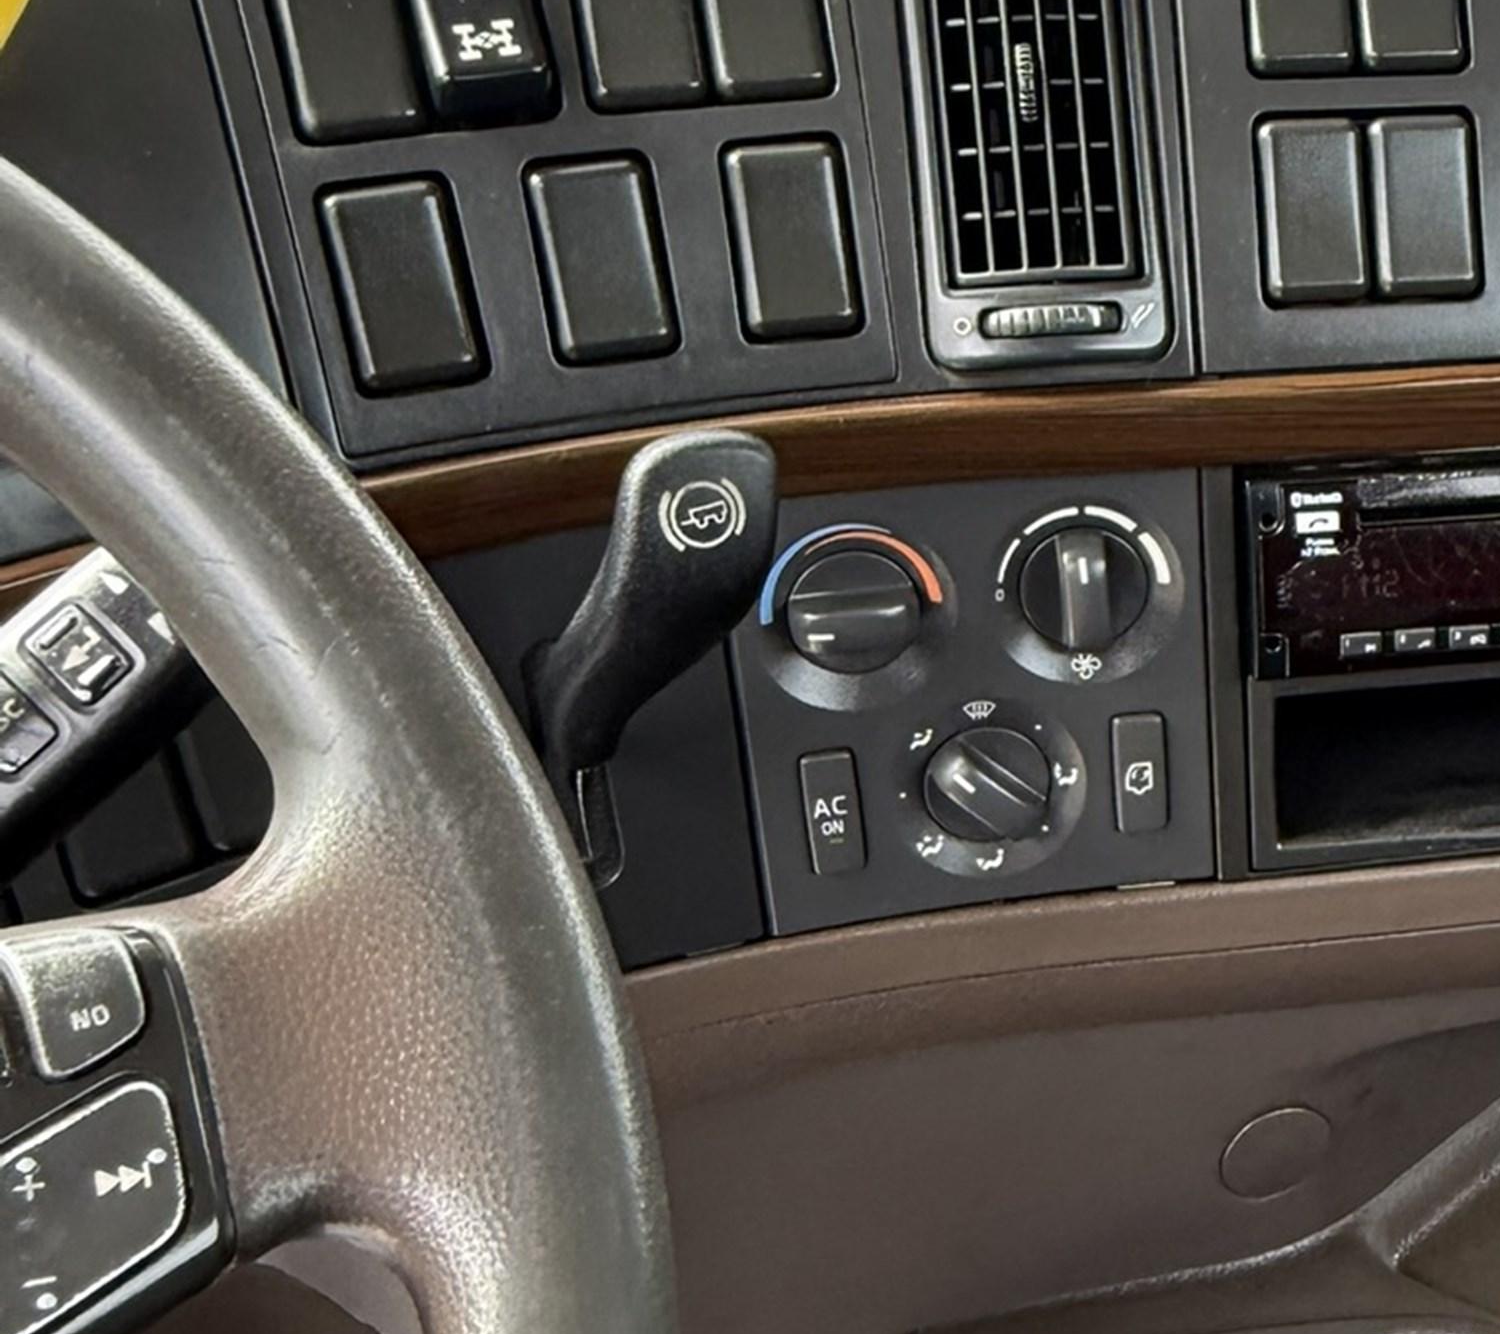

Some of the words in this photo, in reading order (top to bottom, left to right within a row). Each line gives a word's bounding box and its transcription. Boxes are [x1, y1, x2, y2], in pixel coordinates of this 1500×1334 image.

[813, 795, 848, 819] AC
[821, 819, 845, 836] ON
[69, 1003, 111, 1031] NO
